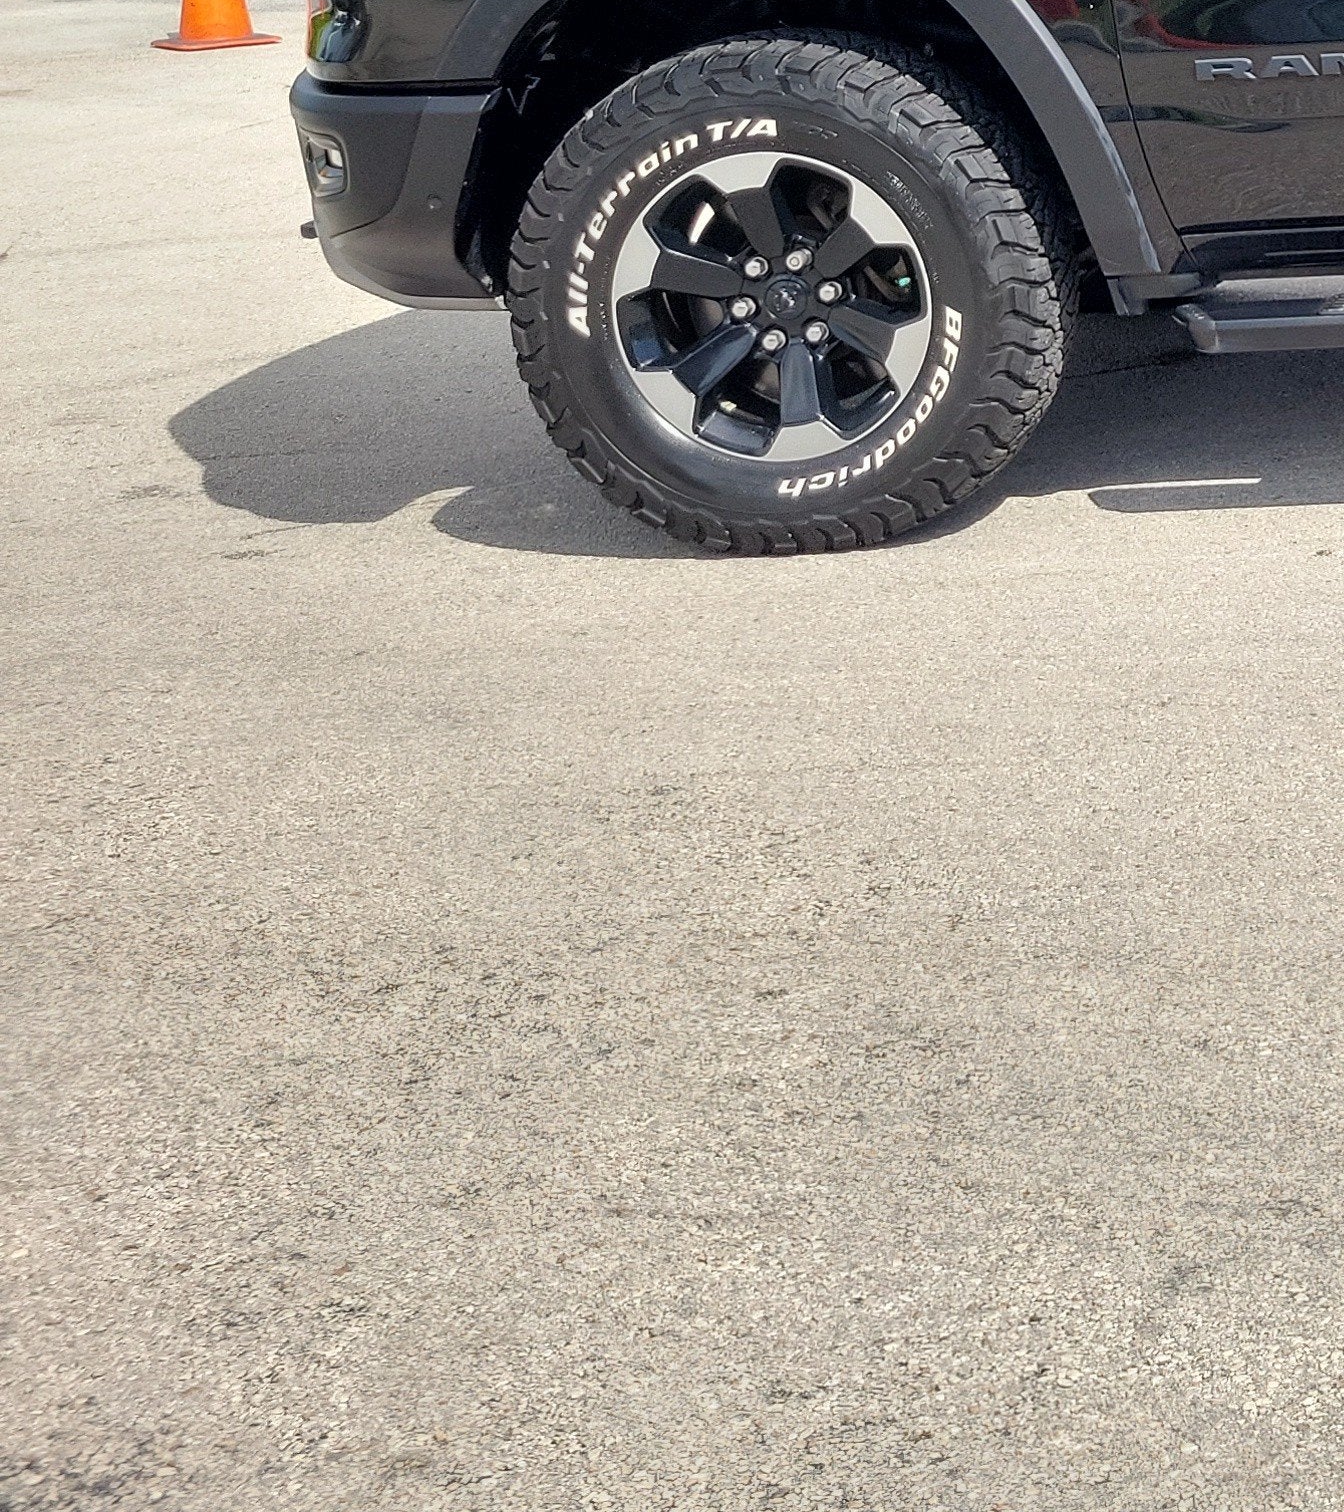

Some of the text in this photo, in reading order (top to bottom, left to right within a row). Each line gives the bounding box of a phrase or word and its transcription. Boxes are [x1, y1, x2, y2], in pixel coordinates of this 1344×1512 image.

[565, 117, 779, 338] All-Terrain T/A
[777, 306, 964, 500] BFGoodrich
